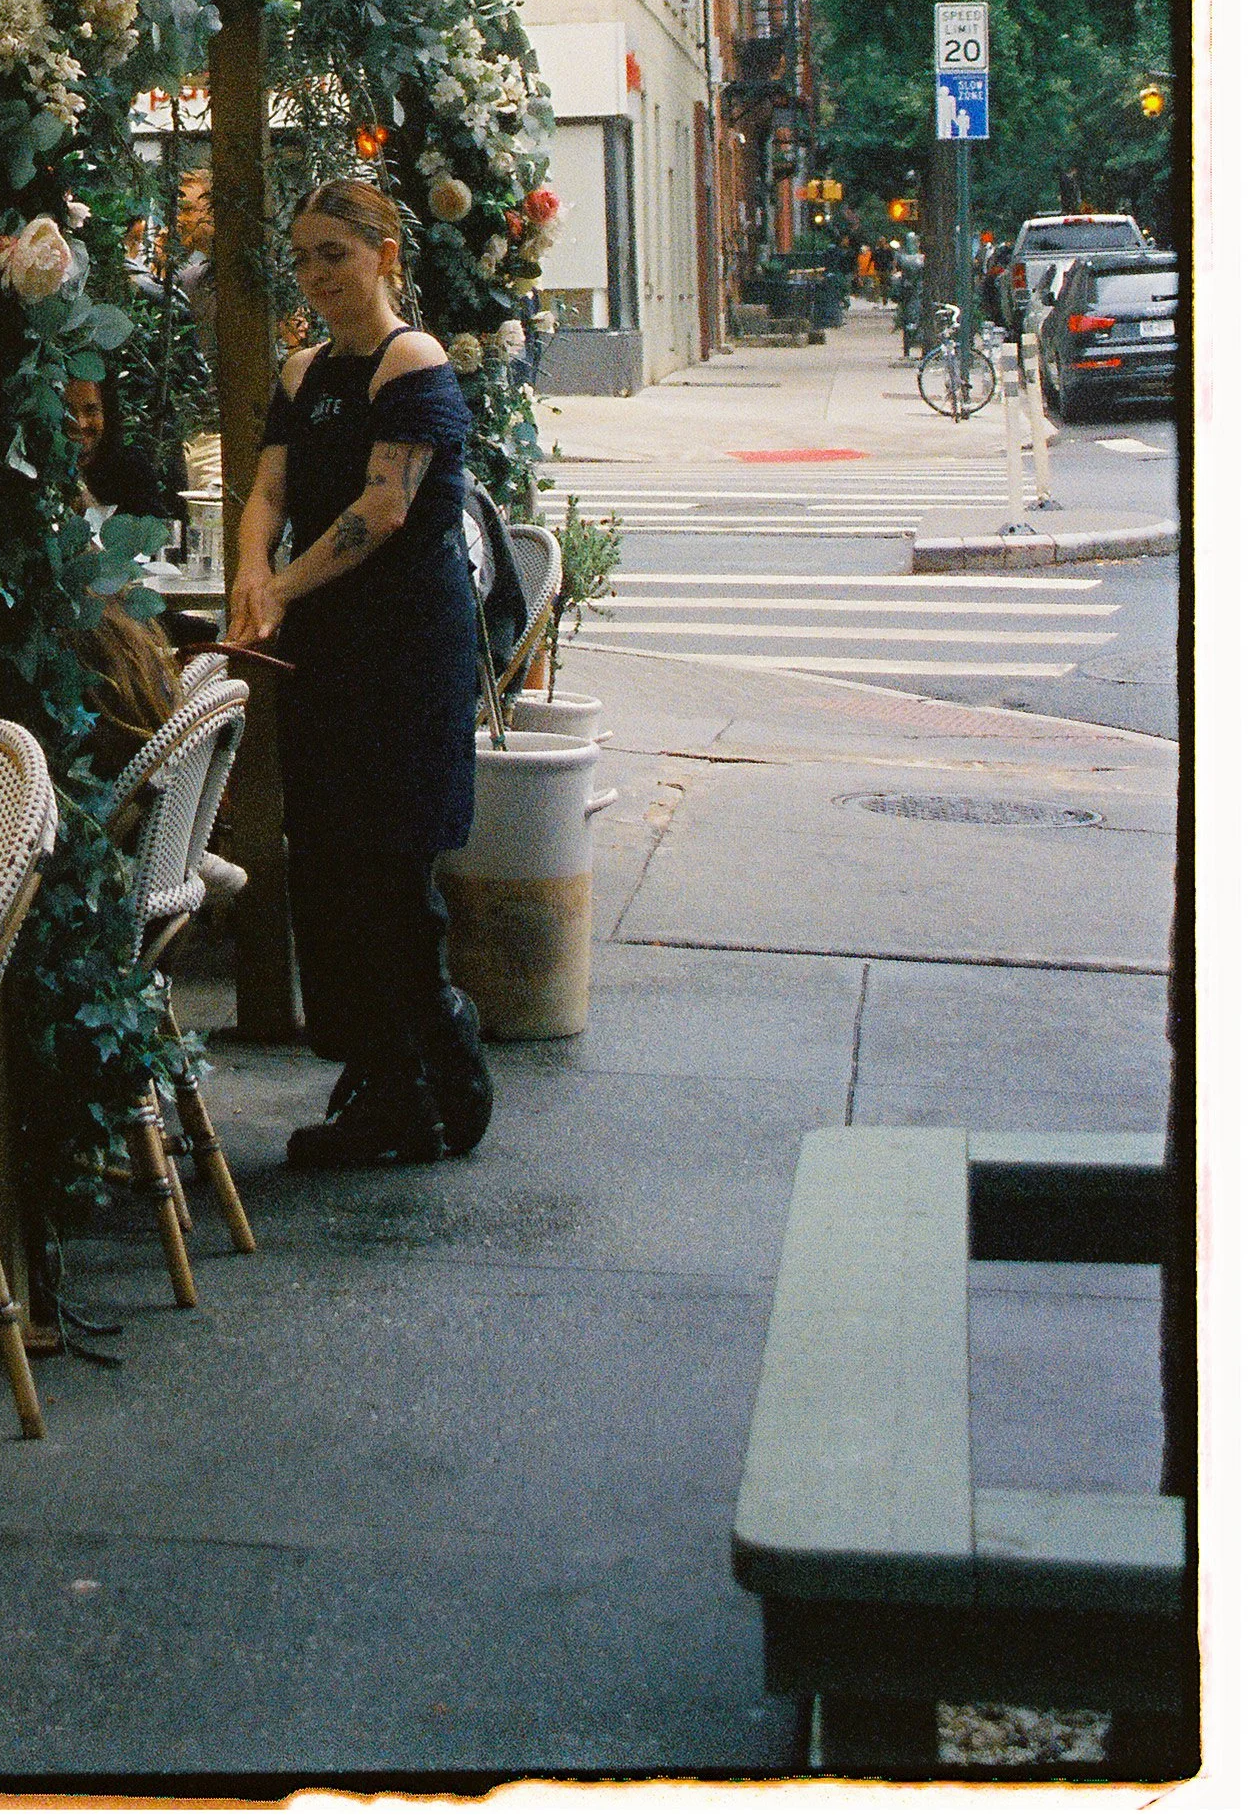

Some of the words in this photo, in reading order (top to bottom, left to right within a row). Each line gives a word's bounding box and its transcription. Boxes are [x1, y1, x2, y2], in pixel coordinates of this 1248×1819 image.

[942, 10, 981, 22] SPEED
[945, 23, 978, 35] LIMIT
[944, 38, 980, 62] 20
[958, 80, 983, 91] SLOW
